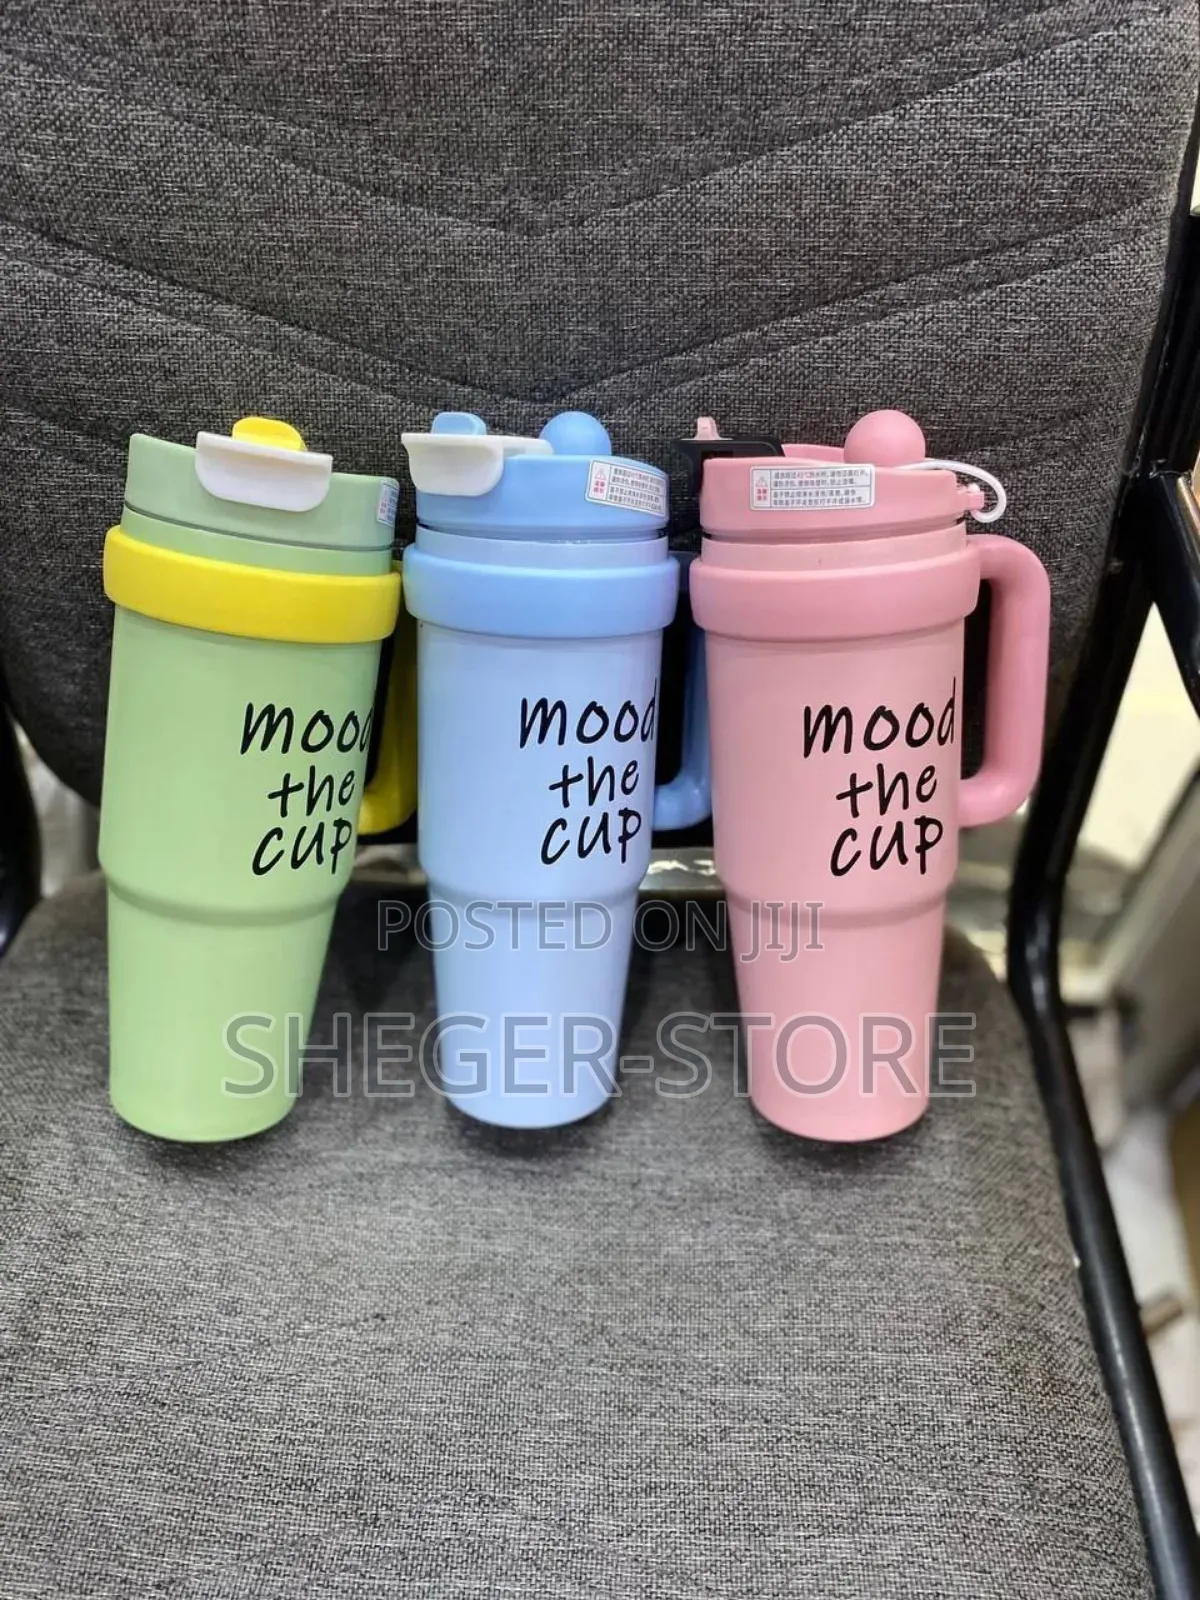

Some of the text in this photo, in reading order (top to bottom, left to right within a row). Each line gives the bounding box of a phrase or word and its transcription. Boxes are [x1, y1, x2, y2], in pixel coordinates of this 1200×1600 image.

[519, 677, 657, 749] mood
[803, 676, 956, 759] mood
[267, 765, 355, 818] the
[549, 756, 640, 808] the
[836, 763, 937, 818] the
[252, 817, 352, 876] cup
[540, 807, 642, 865] cup
[830, 815, 943, 877] cup
